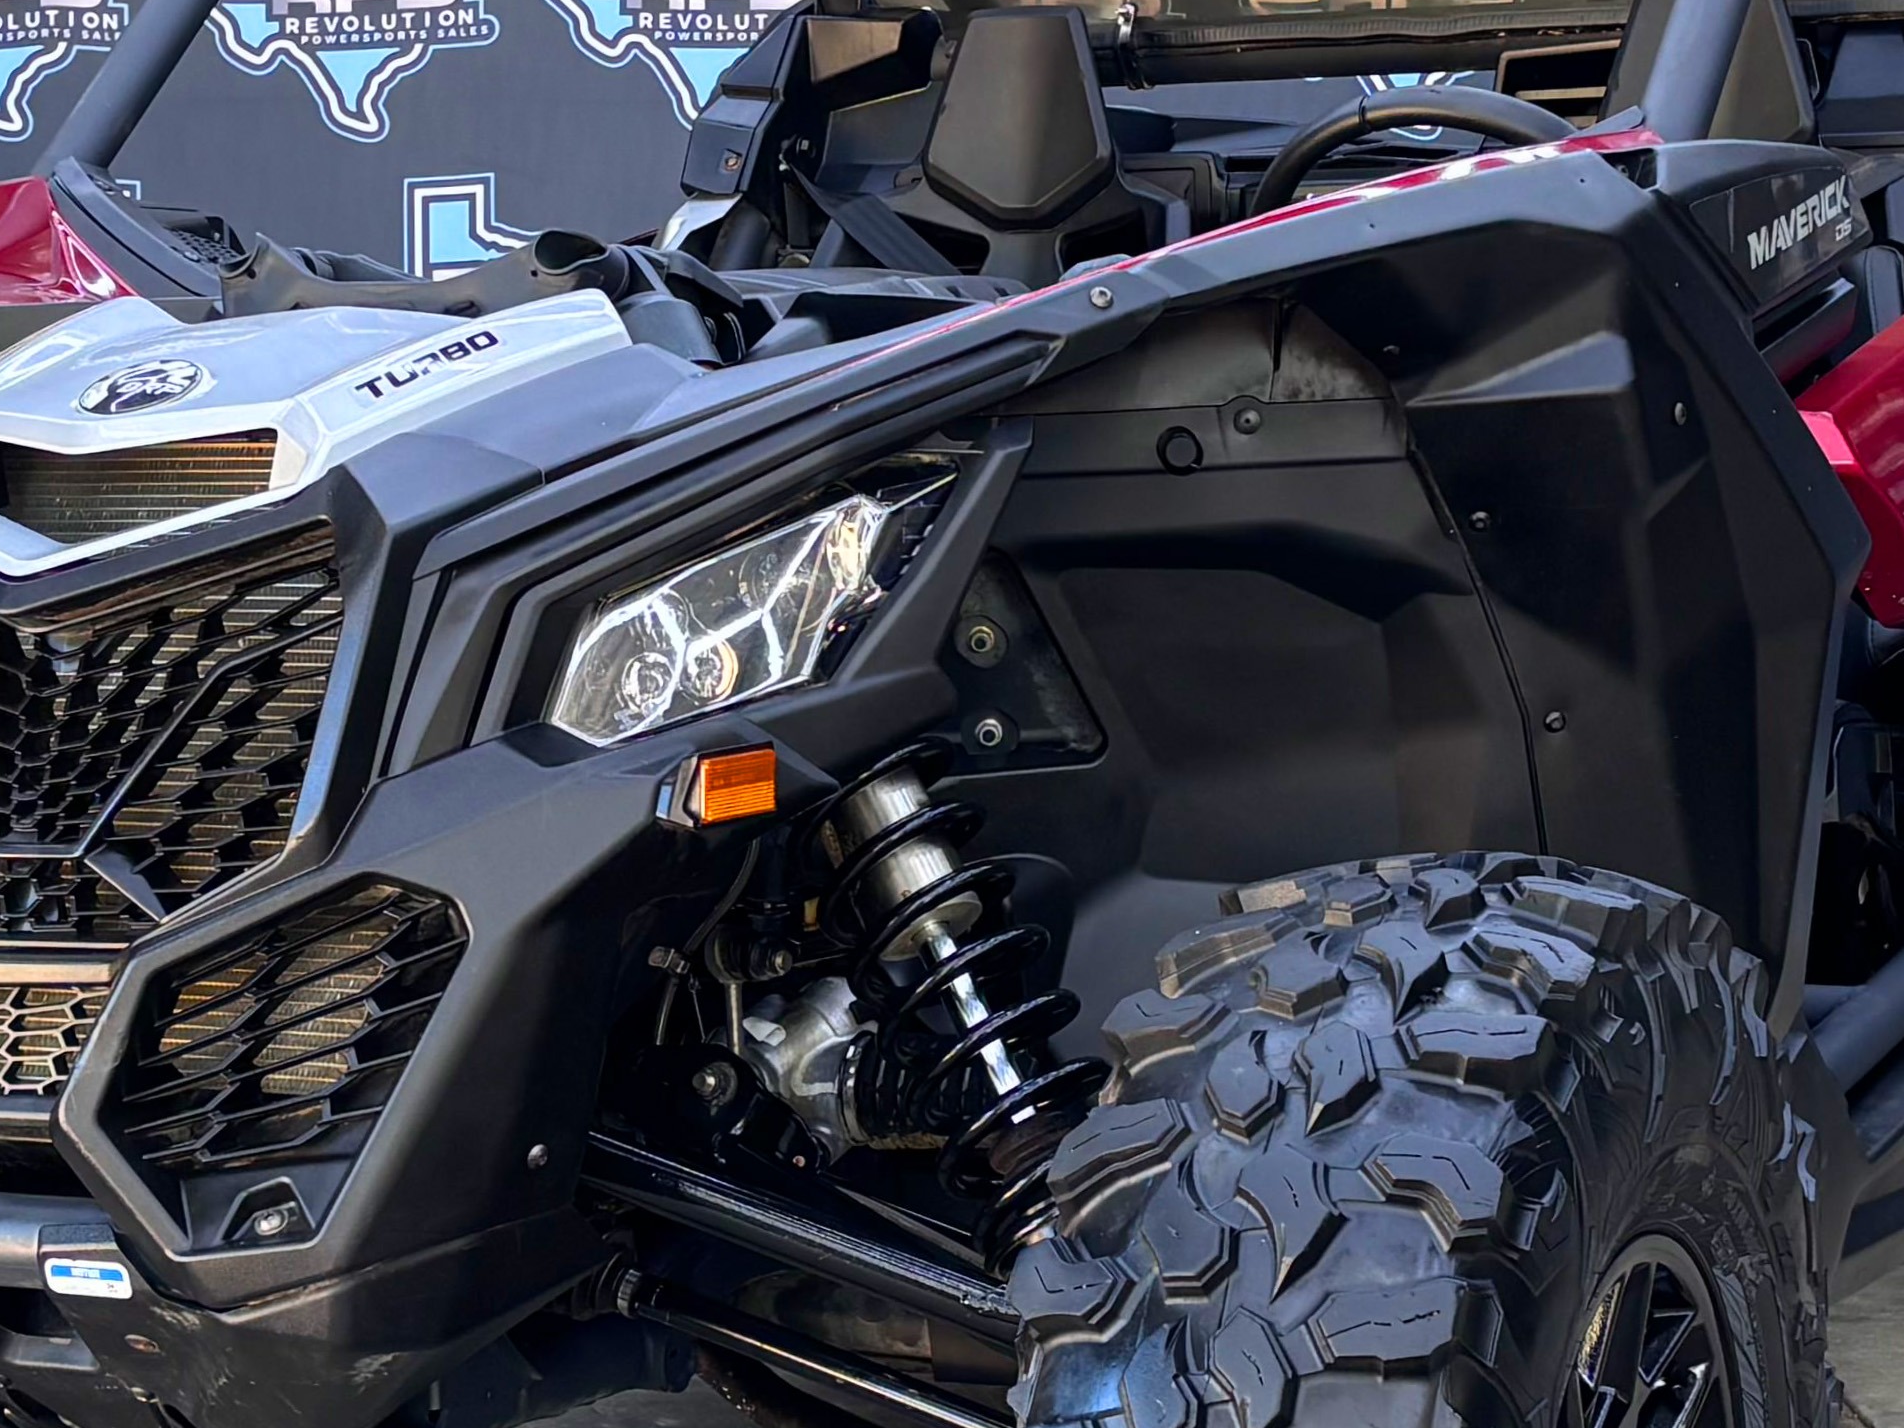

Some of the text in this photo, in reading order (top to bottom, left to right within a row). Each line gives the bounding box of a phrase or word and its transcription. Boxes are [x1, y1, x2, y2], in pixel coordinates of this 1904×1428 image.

[286, 8, 473, 34] REVOLUTION
[301, 25, 488, 44] POWERSPORTS SALES
[1747, 175, 1850, 270] MAVERICK
[1835, 218, 1853, 242] DS
